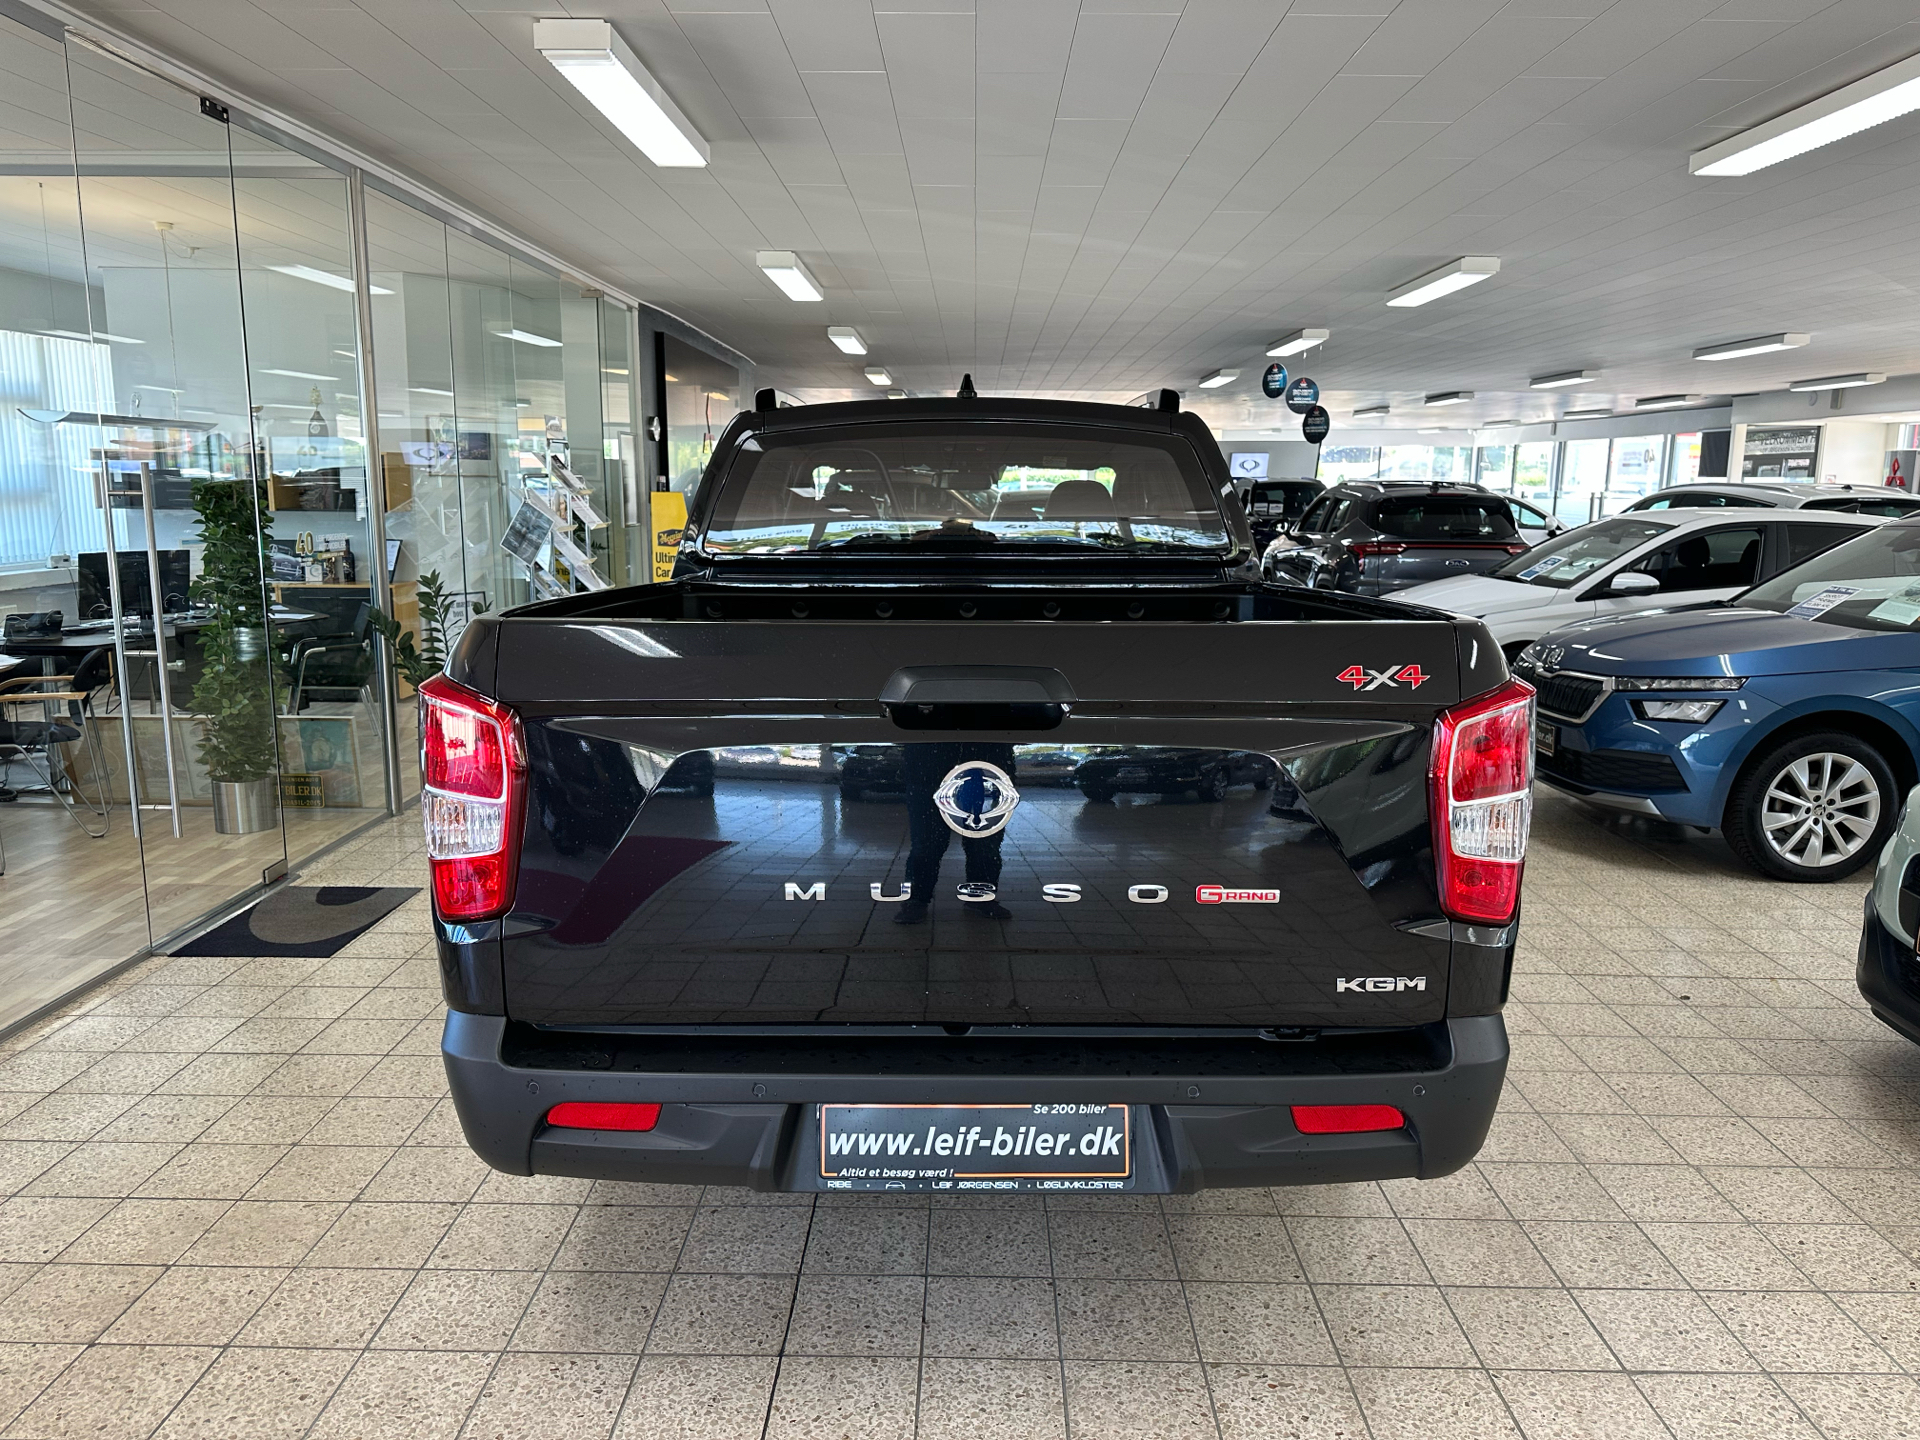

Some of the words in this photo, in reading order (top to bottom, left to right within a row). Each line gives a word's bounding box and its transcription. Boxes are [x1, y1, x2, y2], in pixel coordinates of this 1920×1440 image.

[295, 530, 314, 555] 40
[784, 882, 1169, 904] MUSSO
[1336, 976, 1427, 992] KGM
[1033, 1104, 1048, 1114] Se
[1050, 1104, 1076, 1114] 200
[1078, 1103, 1107, 1114] biler
[829, 1126, 1123, 1156] www.leif-biler.dk
[839, 1168, 867, 1177] Altid
[868, 1169, 880, 1177] et
[882, 1168, 915, 1179] besøg
[919, 1168, 947, 1177] værd
[931, 1181, 953, 1189] LEIF
[956, 1181, 1019, 1189] JØRGENSEN
[1036, 1181, 1124, 1189] LØGUMKLOSTER
